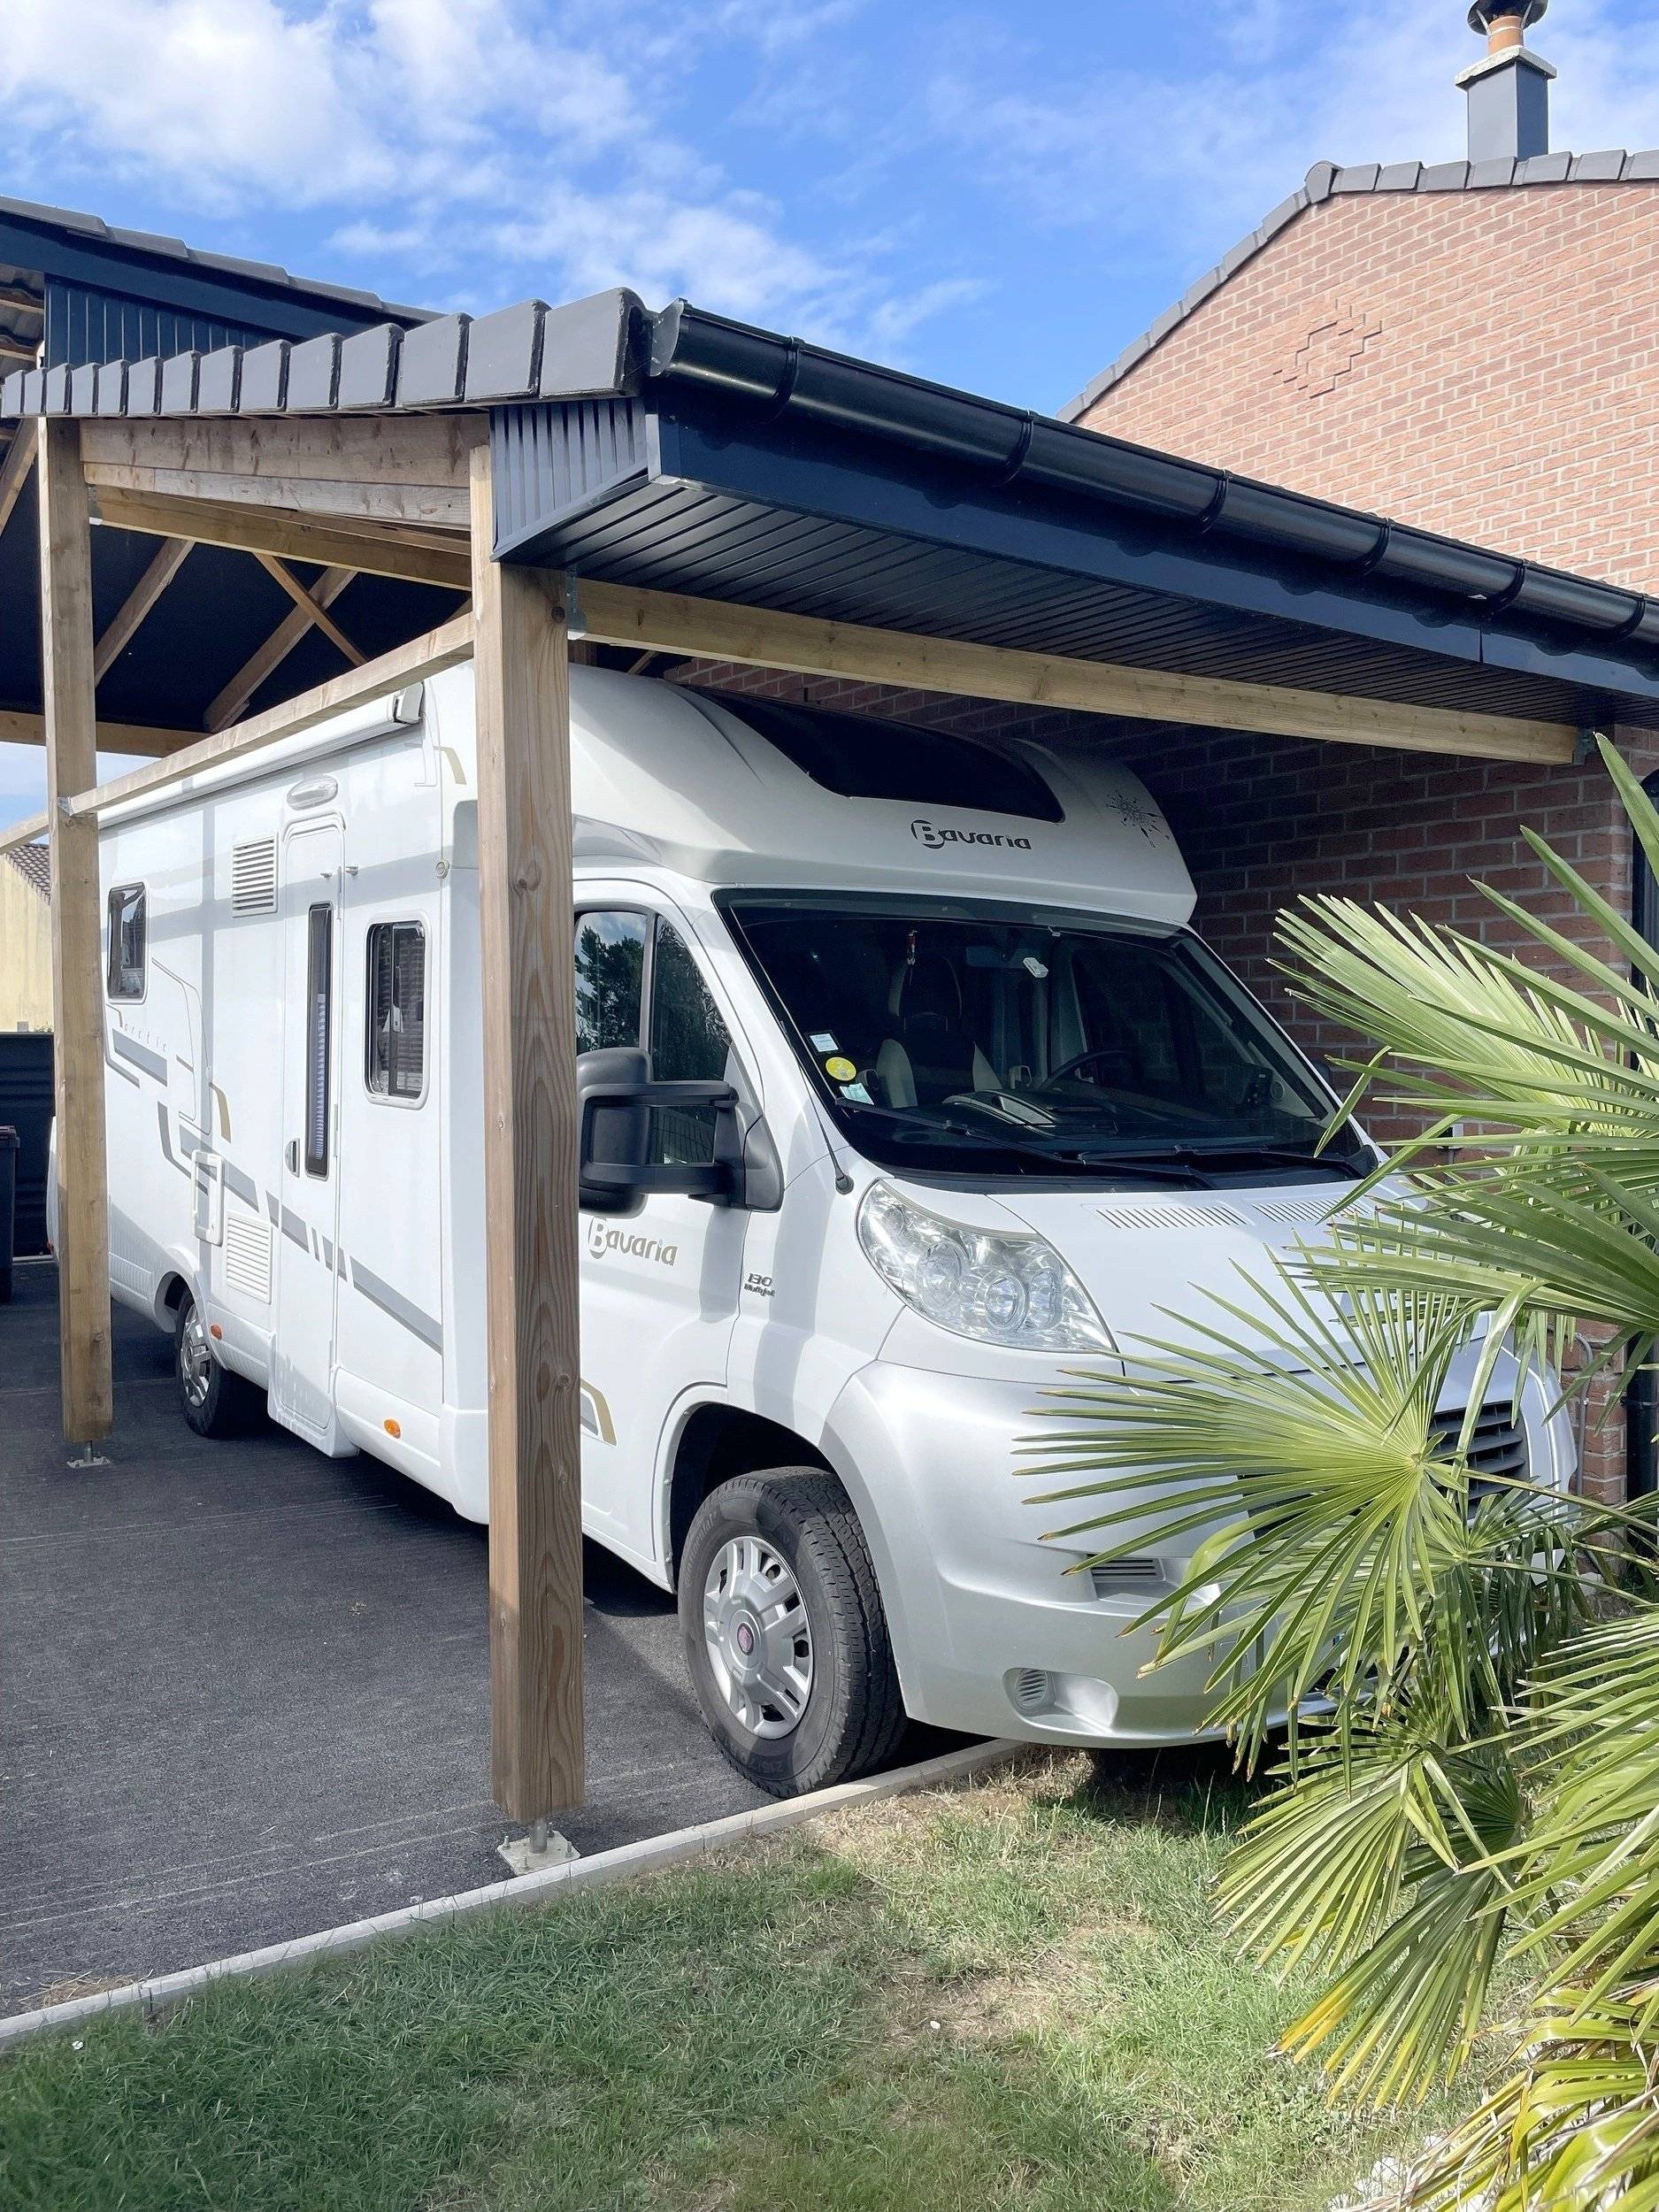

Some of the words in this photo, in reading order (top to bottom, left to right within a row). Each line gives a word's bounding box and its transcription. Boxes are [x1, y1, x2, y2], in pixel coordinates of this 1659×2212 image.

[910, 819, 1032, 849] Bavaria
[588, 1217, 678, 1266] Bavaria
[748, 1273, 772, 1286] 130
